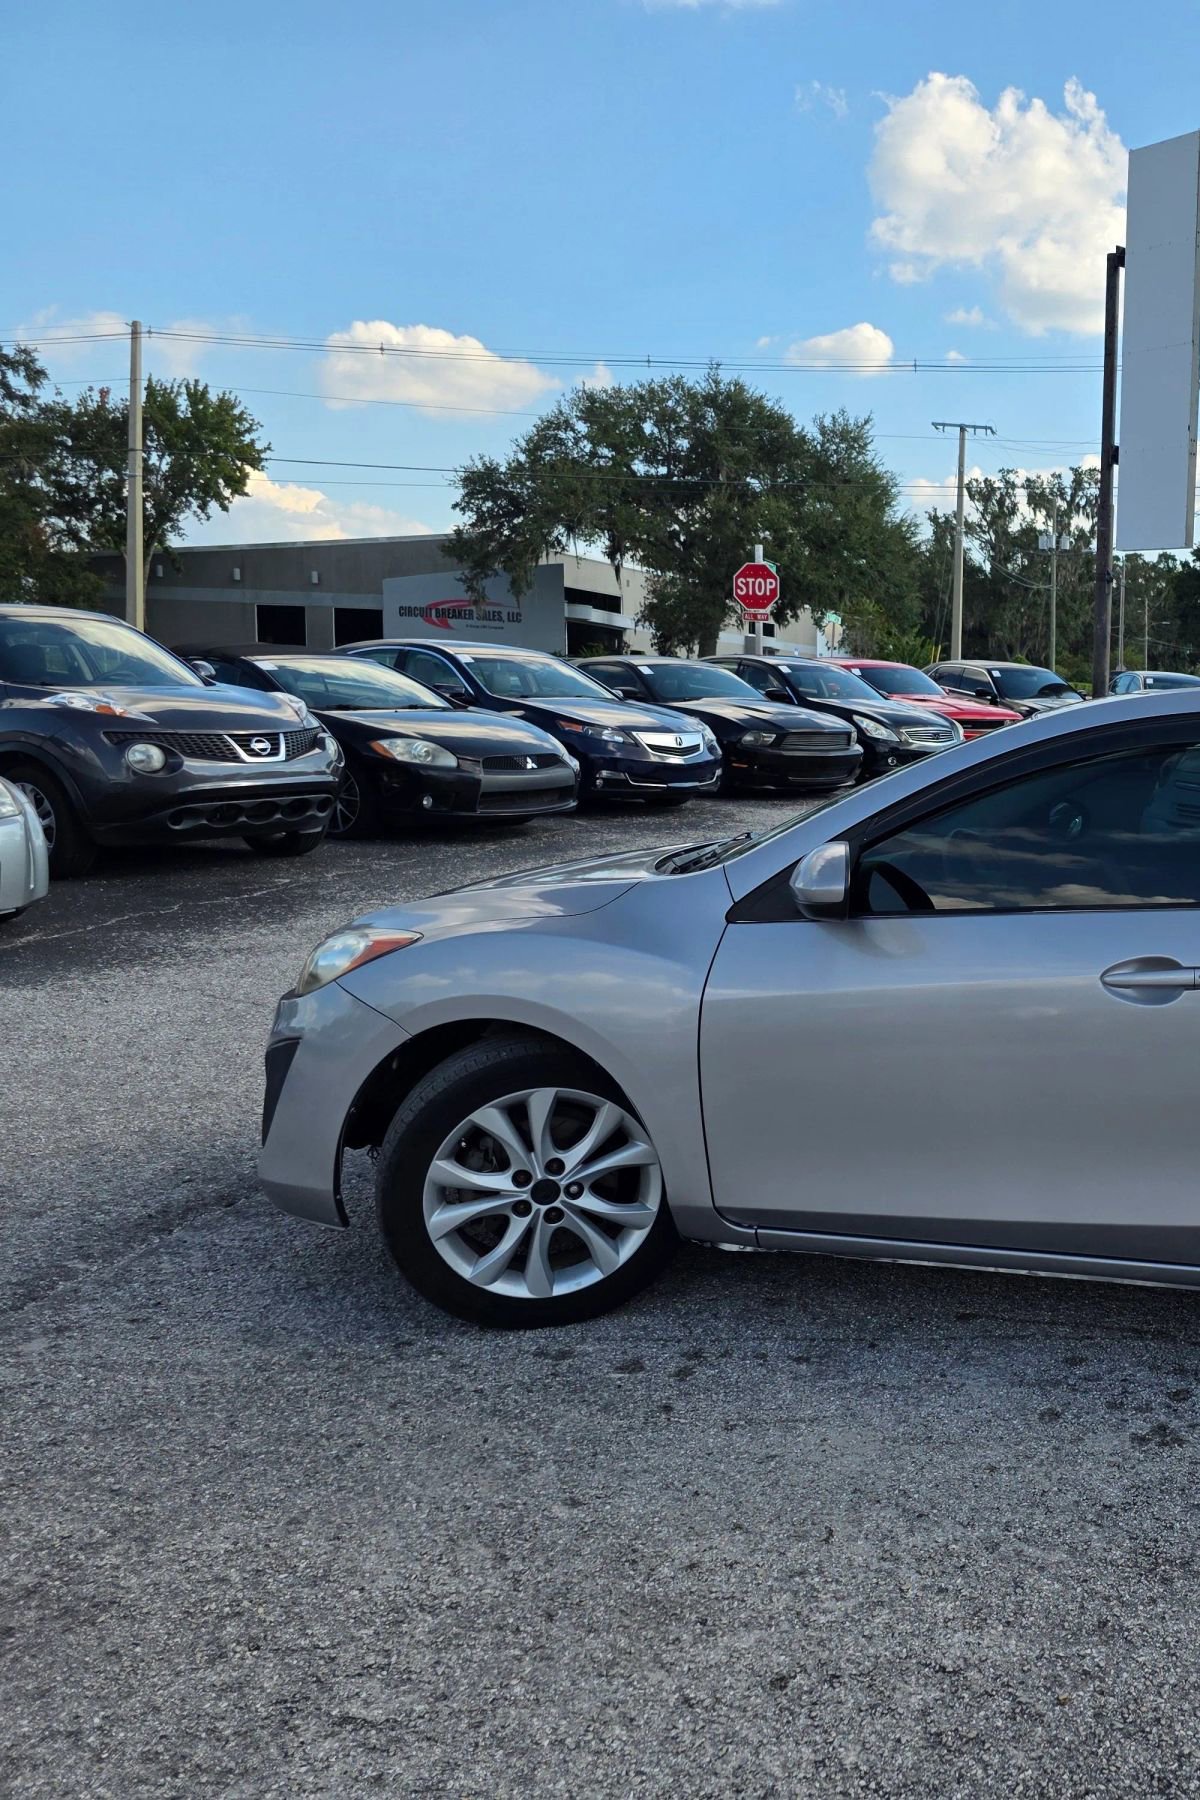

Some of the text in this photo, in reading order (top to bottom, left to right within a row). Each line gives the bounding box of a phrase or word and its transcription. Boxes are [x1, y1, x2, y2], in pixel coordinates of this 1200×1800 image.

[737, 578, 776, 596] STOP
[398, 606, 433, 618] CIRCUIT
[435, 607, 474, 620] BREAKER
[507, 611, 522, 624] LLC
